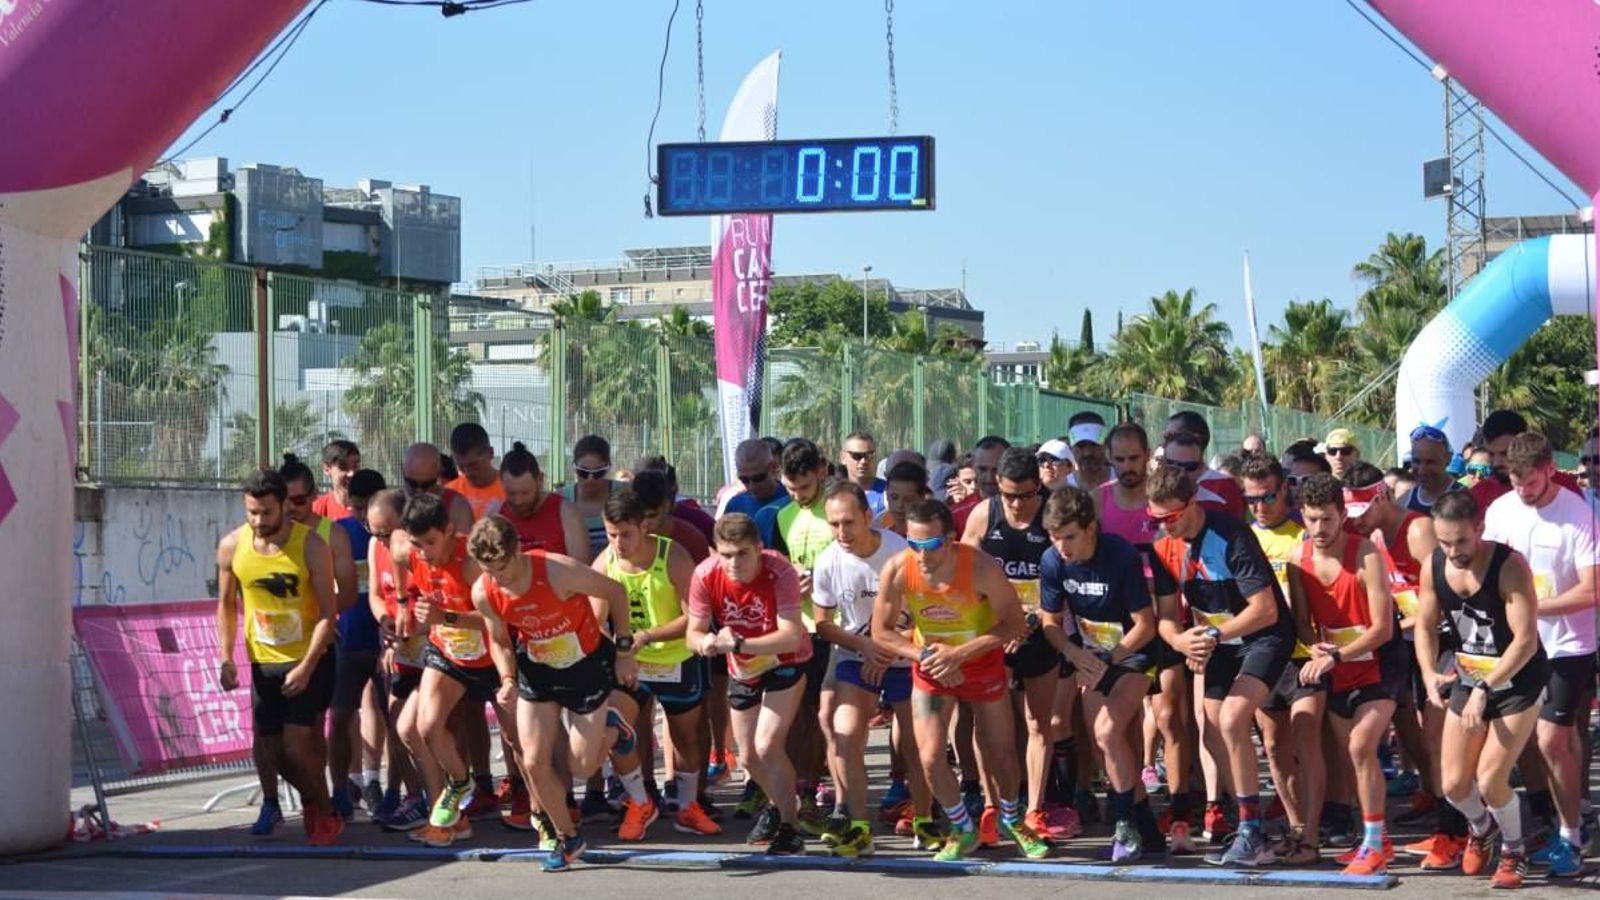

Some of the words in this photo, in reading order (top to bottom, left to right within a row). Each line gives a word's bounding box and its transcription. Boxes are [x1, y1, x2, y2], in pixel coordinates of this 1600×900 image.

[797, 146, 918, 202] 0:00
[1004, 560, 1041, 576] GAE
[193, 700, 246, 745] CER
